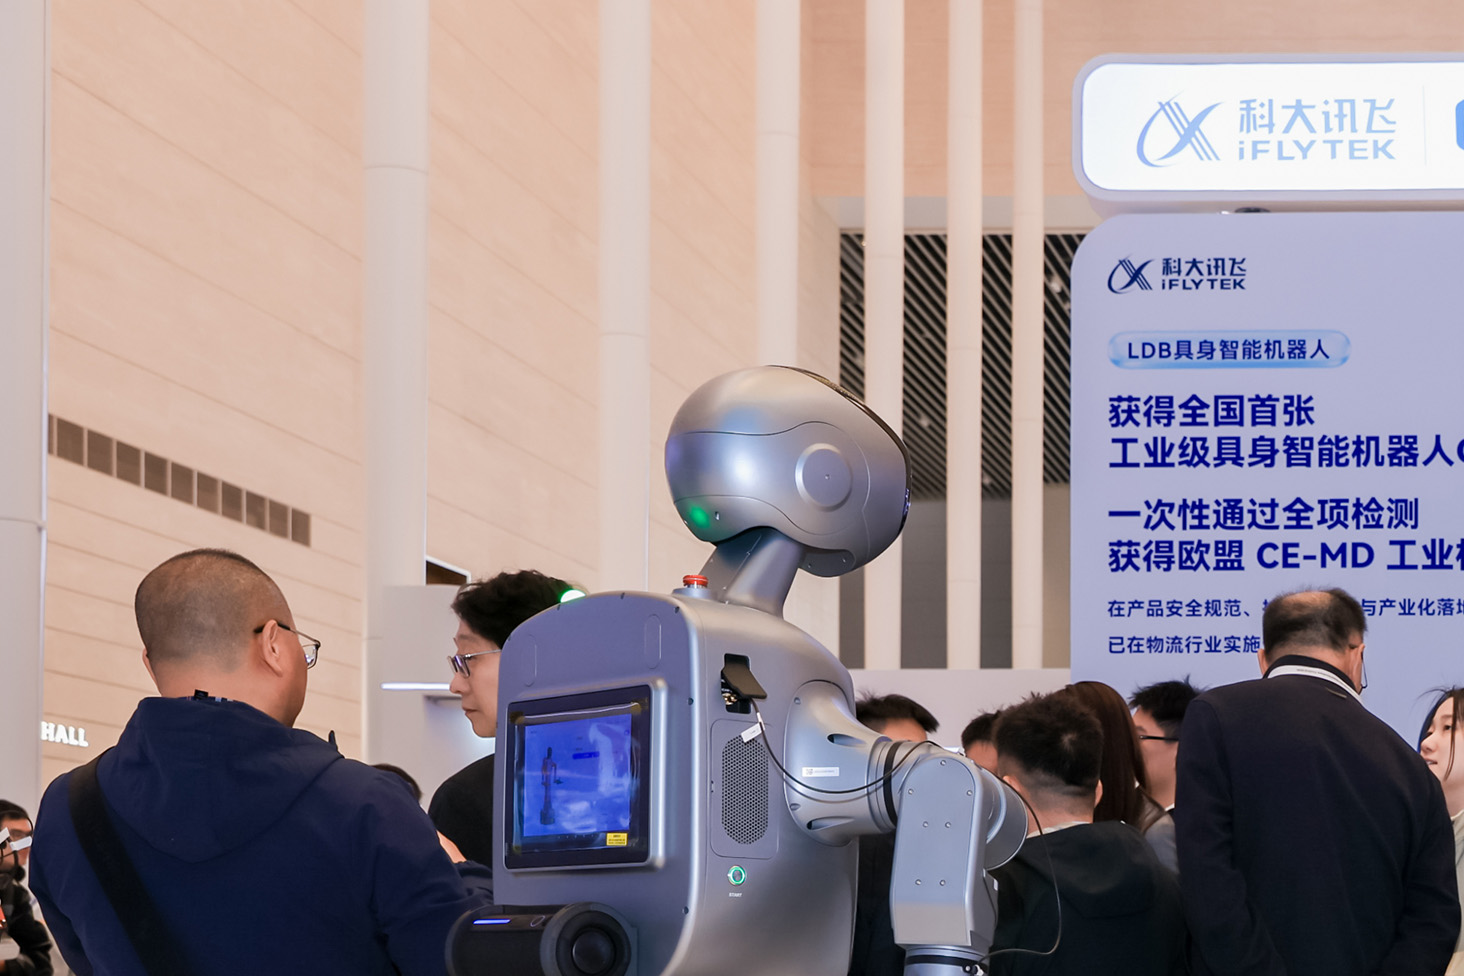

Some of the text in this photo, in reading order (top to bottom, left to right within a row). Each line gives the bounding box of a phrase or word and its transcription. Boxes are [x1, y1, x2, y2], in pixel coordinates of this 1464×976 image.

[1239, 98, 1396, 134] 科大讯飞
[1238, 140, 1396, 161] iFLYTEK
[1161, 257, 1246, 277] 科大讯飞
[1161, 278, 1246, 290] iFLYTEK
[1127, 339, 1331, 360] LDB具身智能机器人
[1108, 394, 1315, 428] 获得全国首张
[1107, 496, 1419, 532] 一次性通过全项检测
[1108, 538, 1245, 572] 获得欧盟
[1256, 541, 1375, 570] CE-MD
[1107, 598, 1269, 618] 在产品安全规范、
[1108, 634, 1261, 655] 已在物流行业实施
[41, 721, 89, 748] HALL
